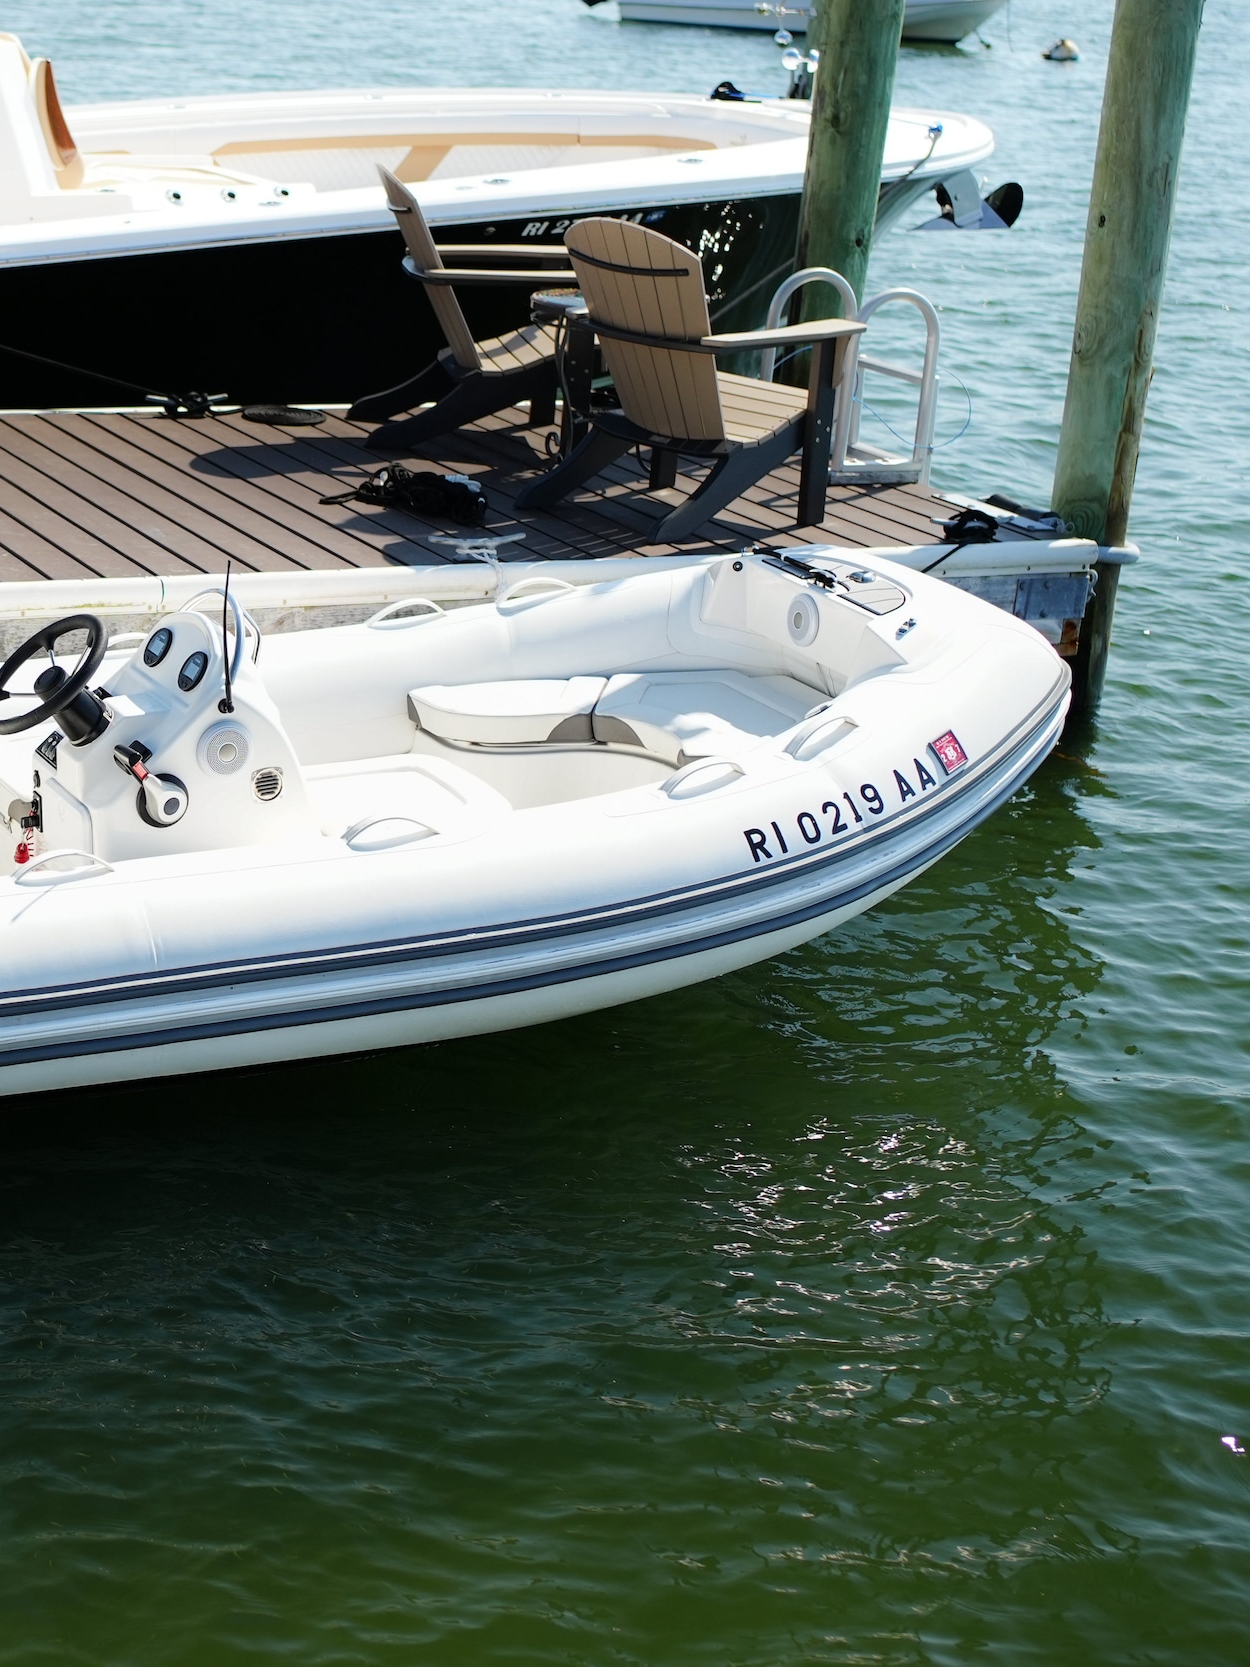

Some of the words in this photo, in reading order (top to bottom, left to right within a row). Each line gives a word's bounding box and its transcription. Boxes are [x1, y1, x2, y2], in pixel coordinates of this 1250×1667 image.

[521, 221, 550, 237] RI
[743, 821, 789, 863] RI
[796, 783, 885, 845] 0219
[893, 758, 937, 803] AA
